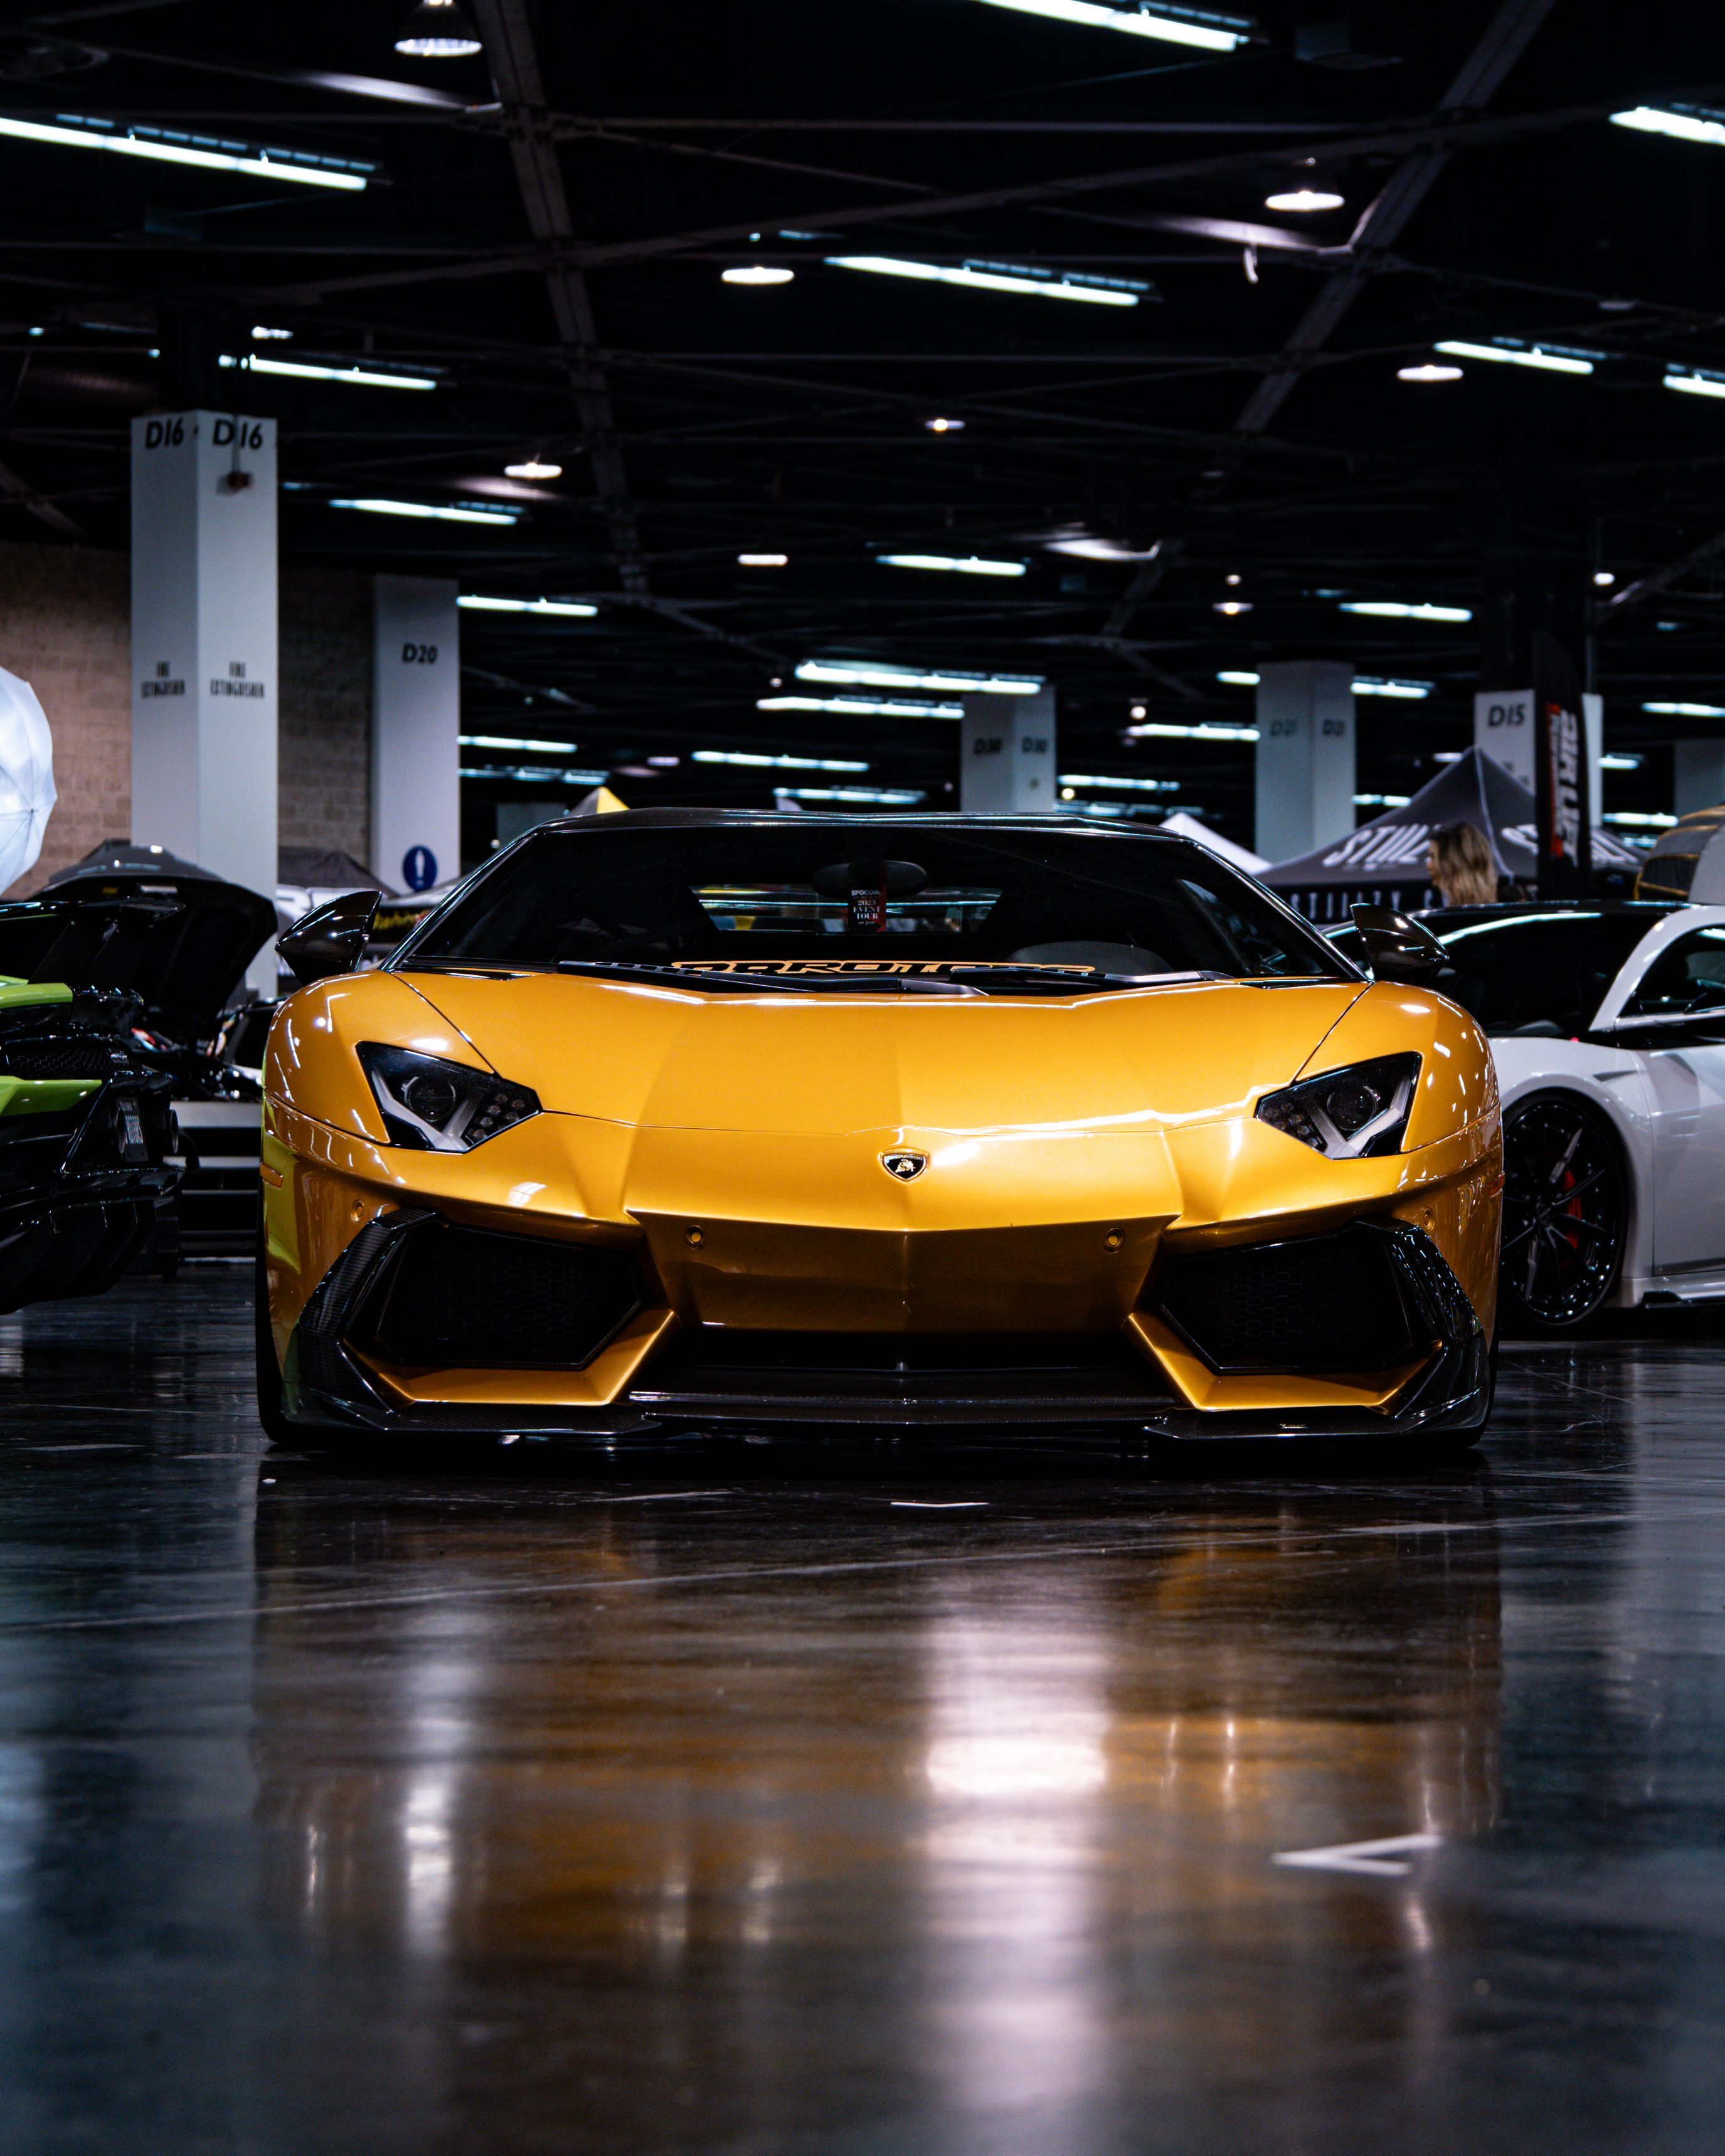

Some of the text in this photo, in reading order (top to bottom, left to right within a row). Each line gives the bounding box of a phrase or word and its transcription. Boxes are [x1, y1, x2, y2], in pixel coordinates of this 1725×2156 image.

[145, 418, 184, 450] D16
[213, 419, 263, 450] D16
[402, 643, 438, 664] D20
[1489, 702, 1525, 727] D15
